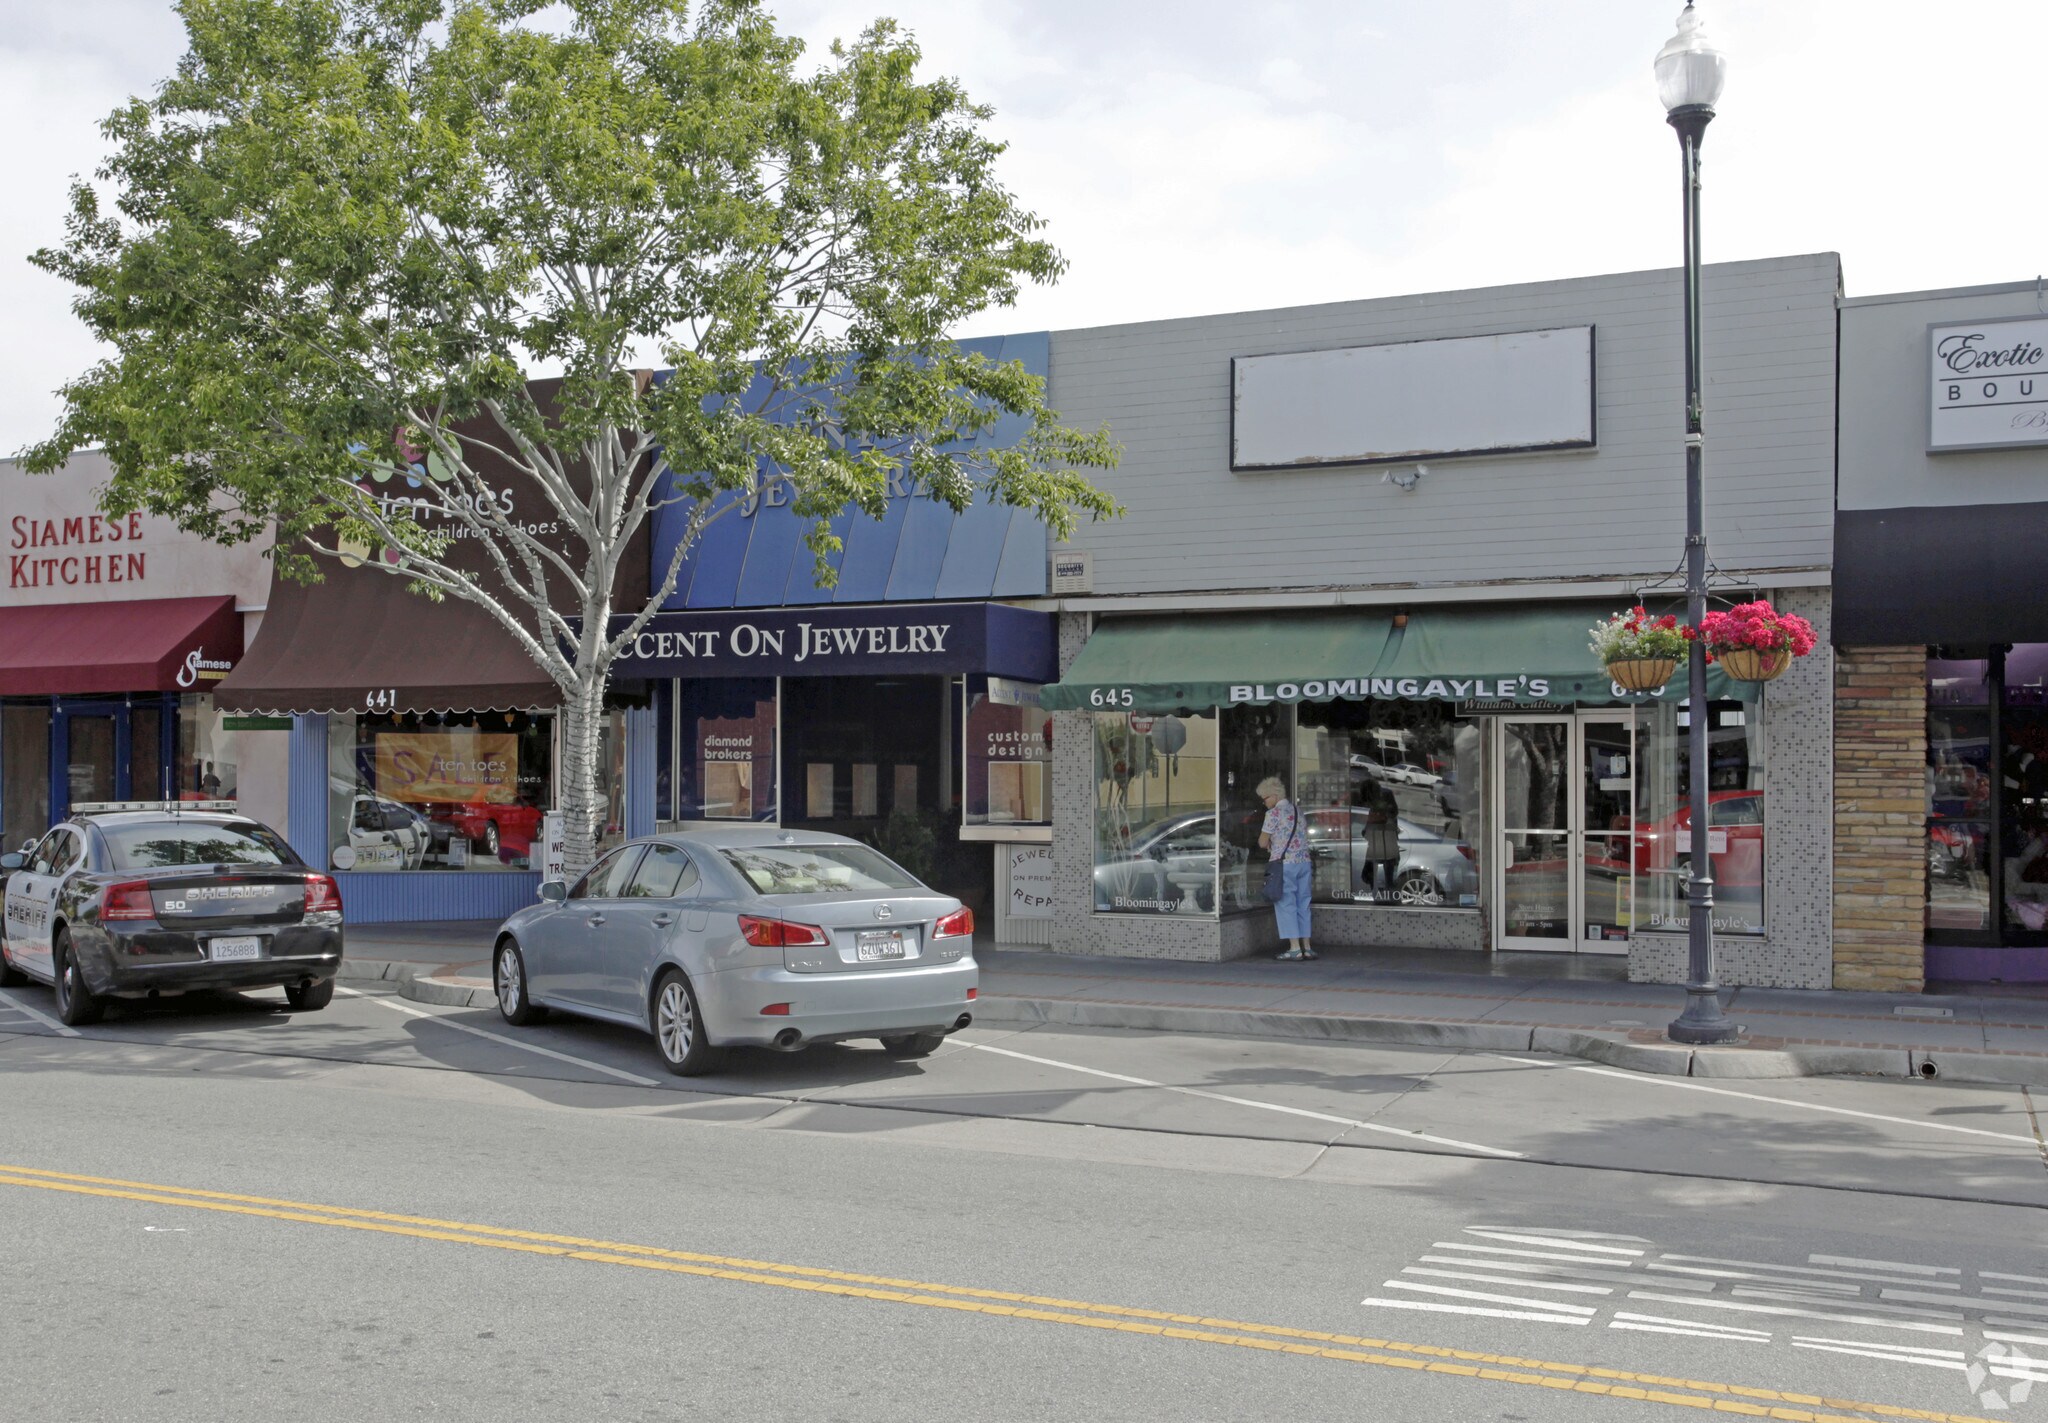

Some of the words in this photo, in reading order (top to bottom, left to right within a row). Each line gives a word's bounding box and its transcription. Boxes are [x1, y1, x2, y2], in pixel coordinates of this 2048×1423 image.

[1937, 334, 2044, 374] Exotic
[11, 512, 143, 549] SIAMESE
[9, 553, 146, 588] KITCHEN
[730, 624, 785, 657] ON
[794, 622, 950, 662] JEWELRY
[176, 646, 232, 688] Siamese
[1090, 688, 1134, 706] 645
[1230, 674, 1550, 702] BLOOMINGAYLE'S
[366, 689, 396, 707] 641
[704, 735, 752, 746] diamond
[987, 731, 1043, 742] custom
[704, 748, 752, 760] brokers
[987, 744, 1043, 759] design
[393, 750, 504, 785] SALE
[438, 758, 466, 771] ten
[470, 758, 507, 772] toes
[513, 775, 542, 784] shoes
[186, 885, 275, 900] SHERIFF
[1375, 890, 1390, 900] All
